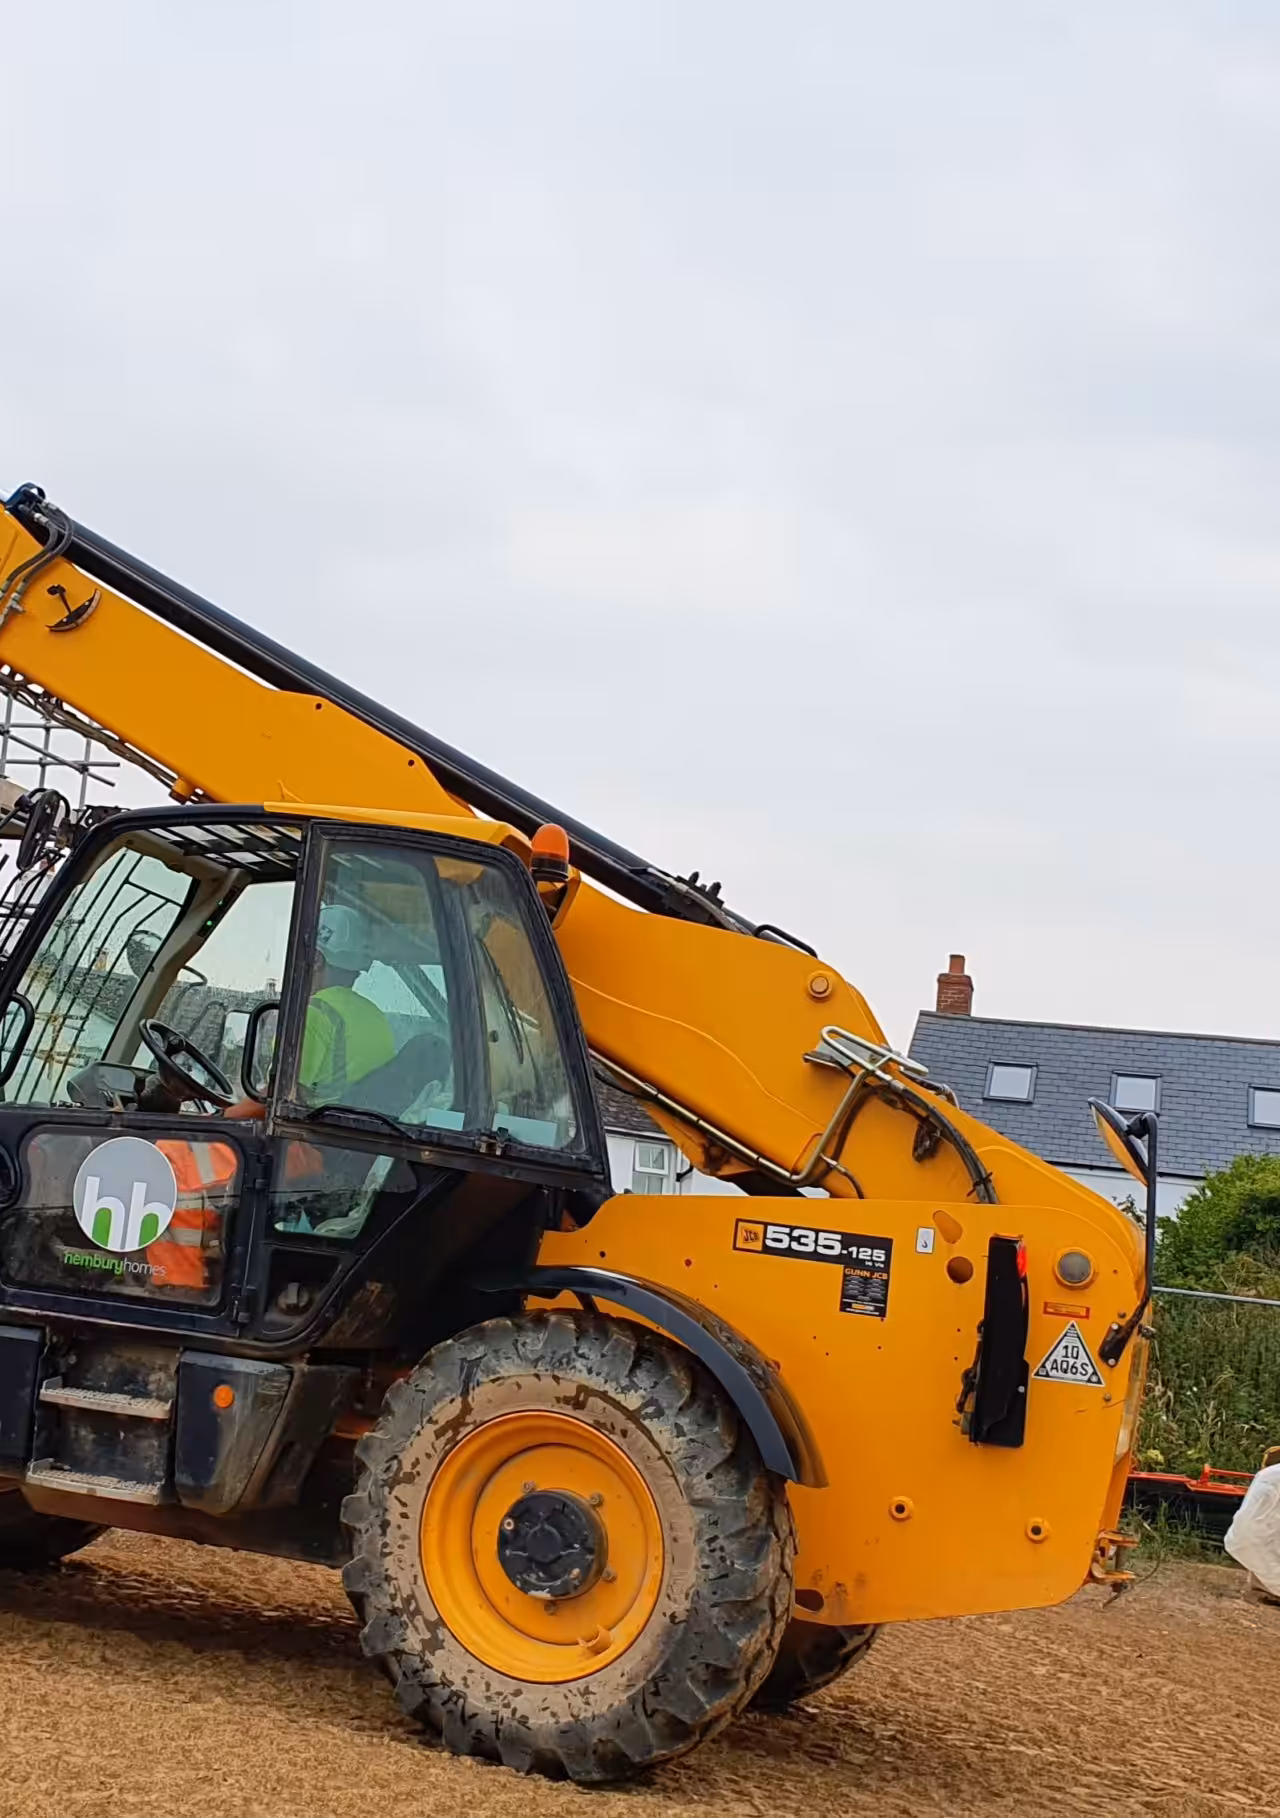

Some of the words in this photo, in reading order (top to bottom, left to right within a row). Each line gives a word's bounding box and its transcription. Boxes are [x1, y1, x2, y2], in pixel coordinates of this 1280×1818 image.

[765, 1225, 886, 1262] 535-125
[844, 1268, 871, 1278] GUNN
[872, 1272, 888, 1280] JCB
[1050, 1358, 1089, 1376] AQ6S
